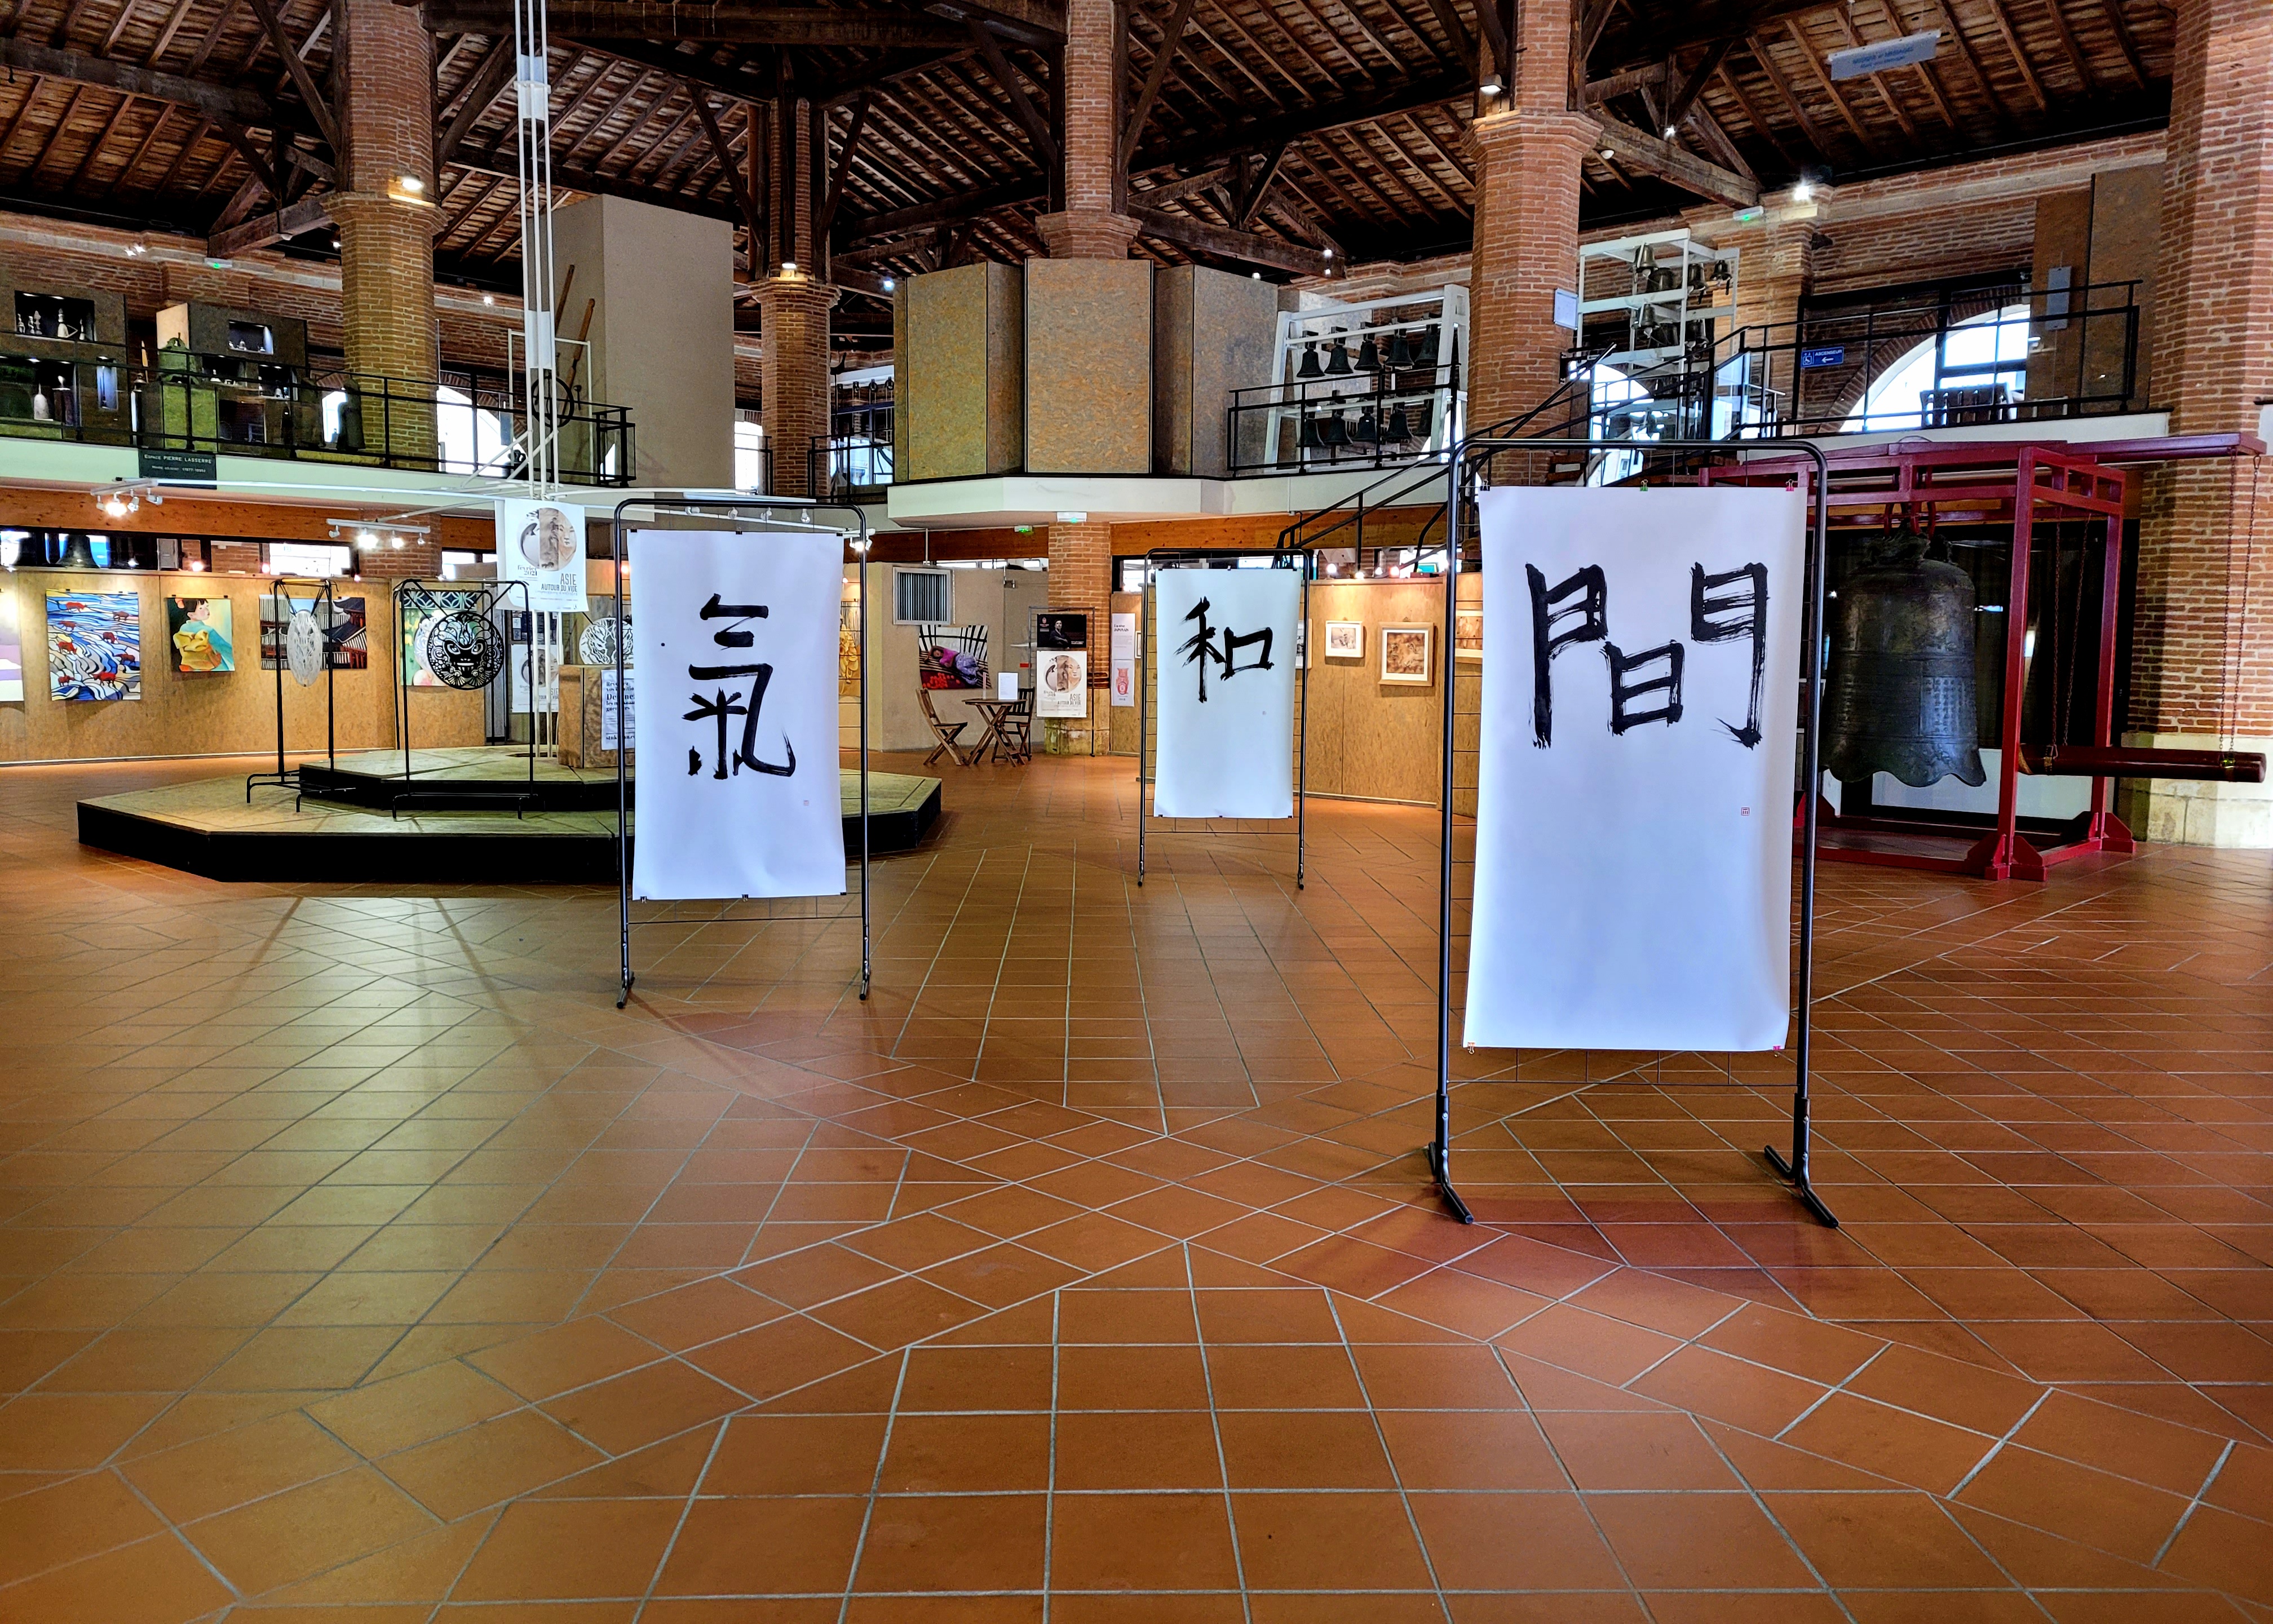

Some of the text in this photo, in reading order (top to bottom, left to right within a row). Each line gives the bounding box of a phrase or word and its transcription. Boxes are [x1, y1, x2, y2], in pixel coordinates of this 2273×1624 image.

[541, 583, 560, 591] AUTOUR
[560, 573, 577, 586] ASIE
[1173, 595, 1275, 703] 和
[1525, 562, 1769, 750] 間
